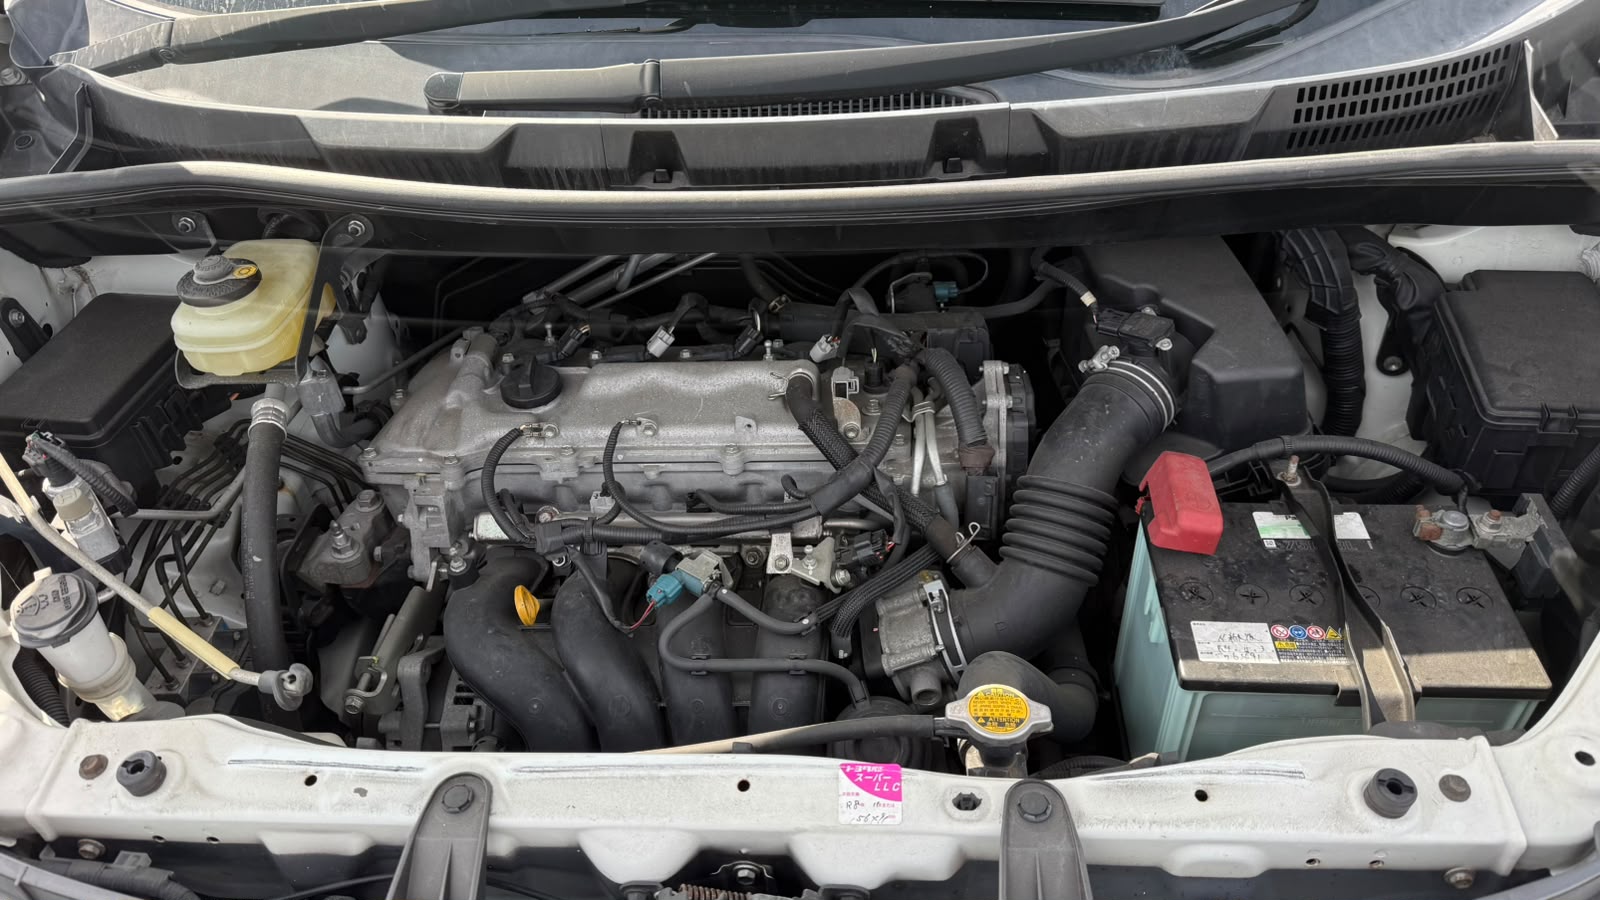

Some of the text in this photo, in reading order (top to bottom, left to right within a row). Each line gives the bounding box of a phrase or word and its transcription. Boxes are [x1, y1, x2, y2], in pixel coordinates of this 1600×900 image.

[854, 773, 891, 782] スーパー
[874, 782, 901, 792] LLC
